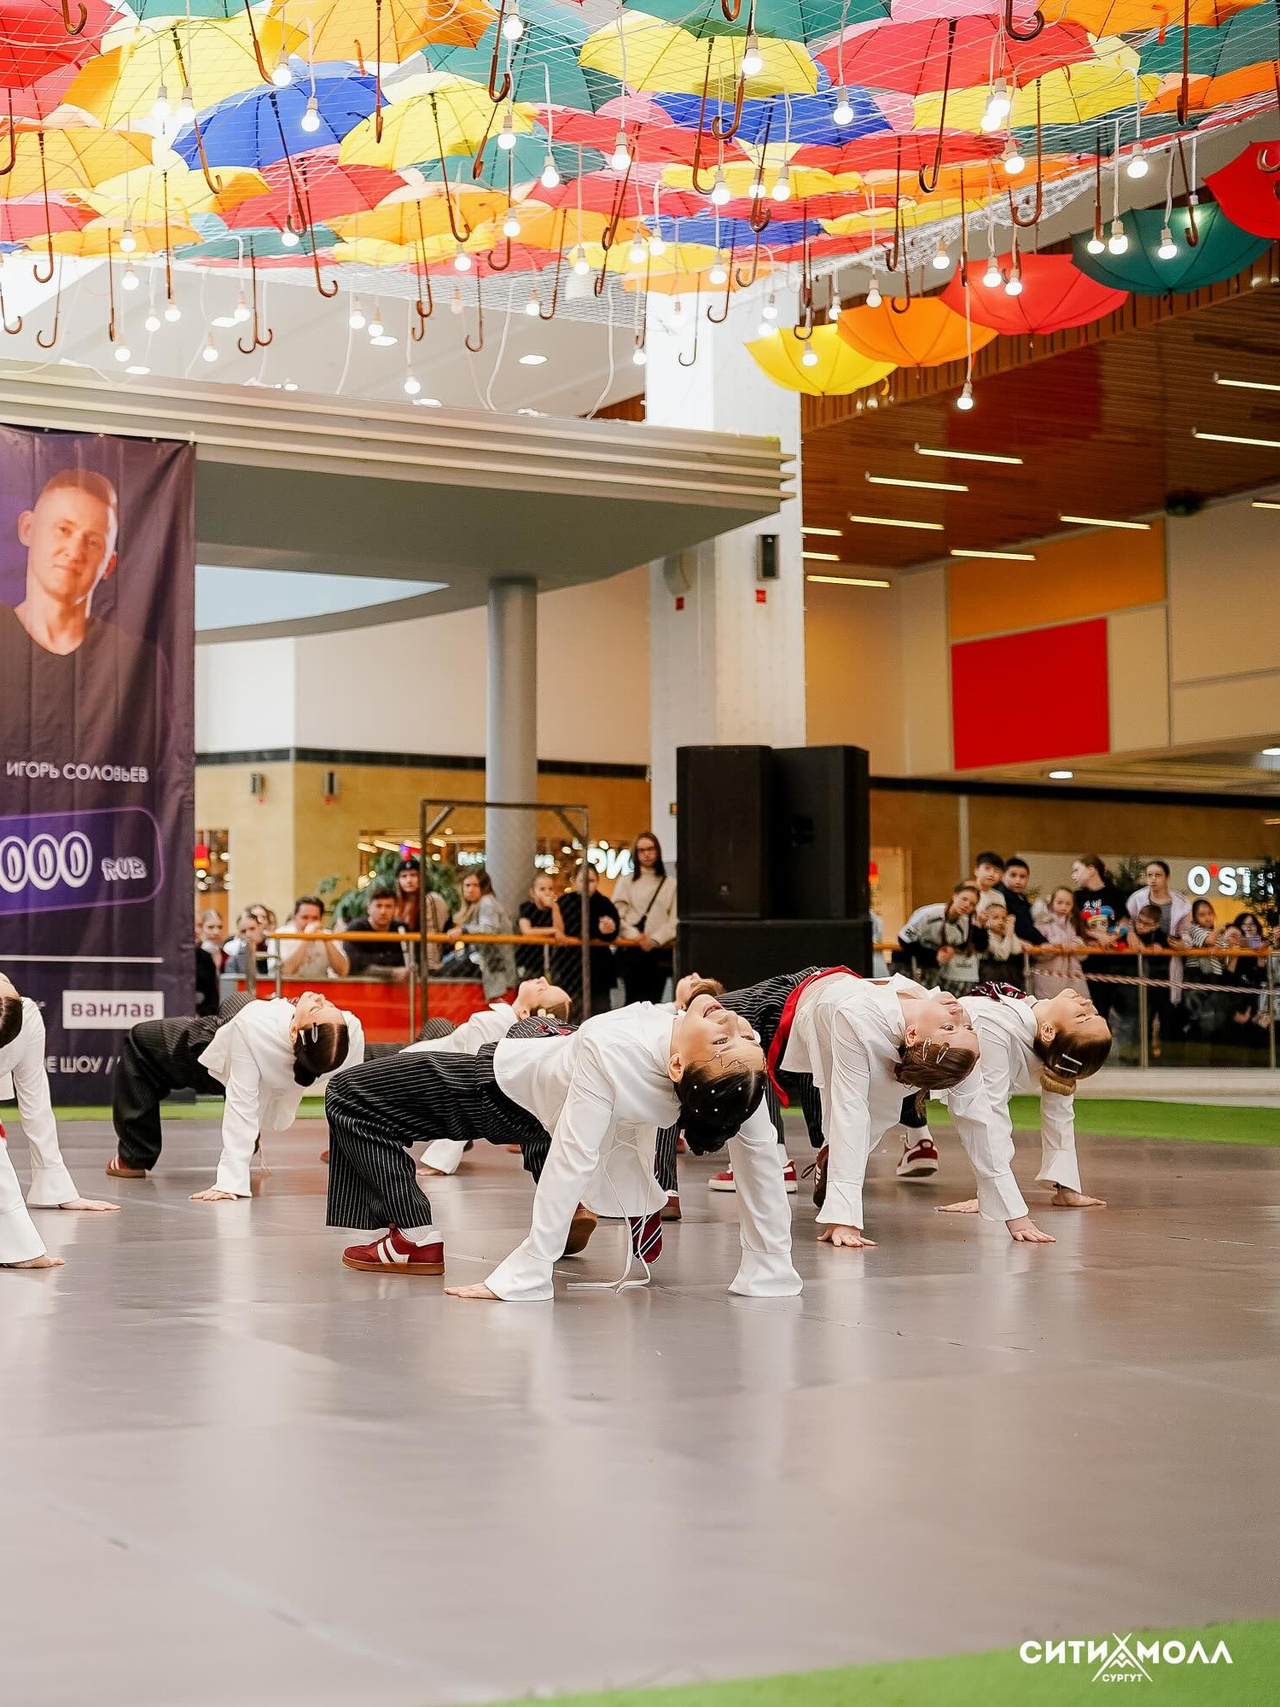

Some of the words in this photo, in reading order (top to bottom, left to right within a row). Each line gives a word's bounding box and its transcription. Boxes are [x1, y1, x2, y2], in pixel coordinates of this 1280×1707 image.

[6, 761, 61, 780] ИГОРЬ
[62, 763, 150, 783] СОЛОВЬЕВ
[101, 857, 148, 881] RUB
[71, 1003, 155, 1018] ванлав
[60, 1055, 103, 1074] ШОУ
